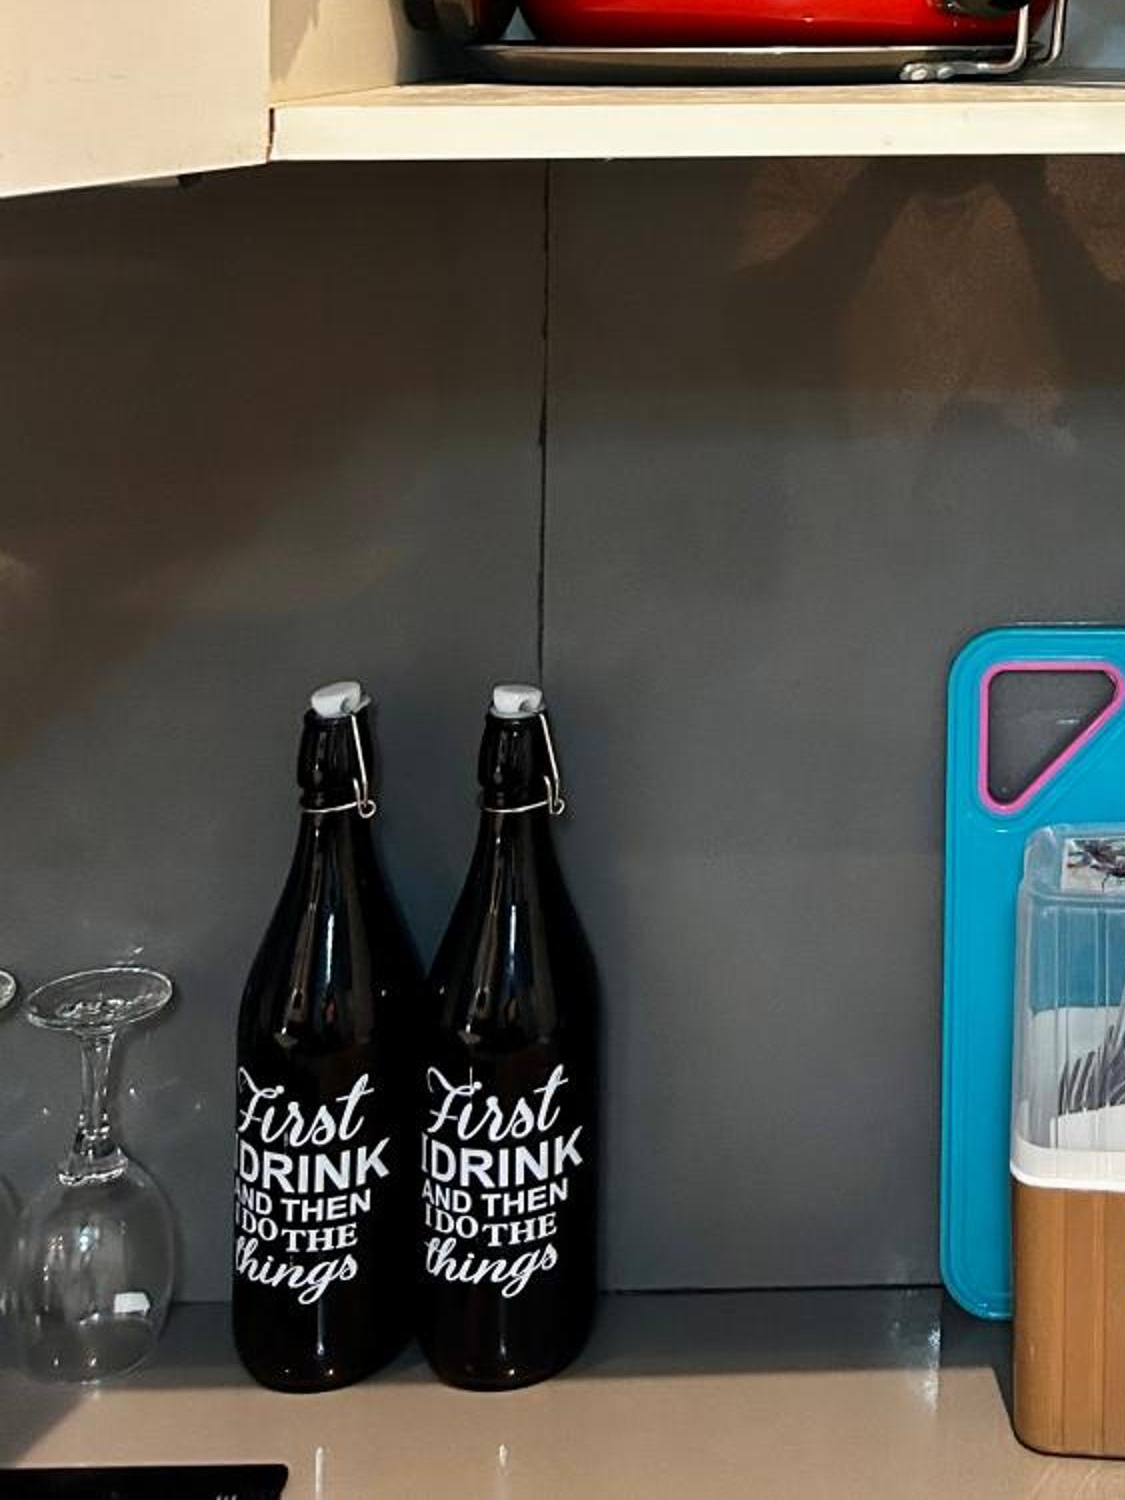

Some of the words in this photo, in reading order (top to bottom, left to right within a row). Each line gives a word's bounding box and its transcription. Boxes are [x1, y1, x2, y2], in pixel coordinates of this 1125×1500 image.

[238, 1065, 374, 1147] First
[427, 1063, 568, 1142] First
[239, 1137, 390, 1193] DRINK
[421, 1132, 428, 1173] I
[431, 1125, 584, 1189] DRINK
[235, 1176, 272, 1215] AND
[280, 1188, 371, 1222] THEN
[421, 1177, 472, 1214] AND
[481, 1178, 569, 1217] THEN
[425, 1203, 432, 1227] I
[436, 1210, 479, 1239] DO
[482, 1212, 557, 1247] THE
[242, 1207, 278, 1241] DO
[281, 1221, 358, 1252] THE
[235, 1235, 358, 1305] things
[424, 1237, 559, 1299] things
